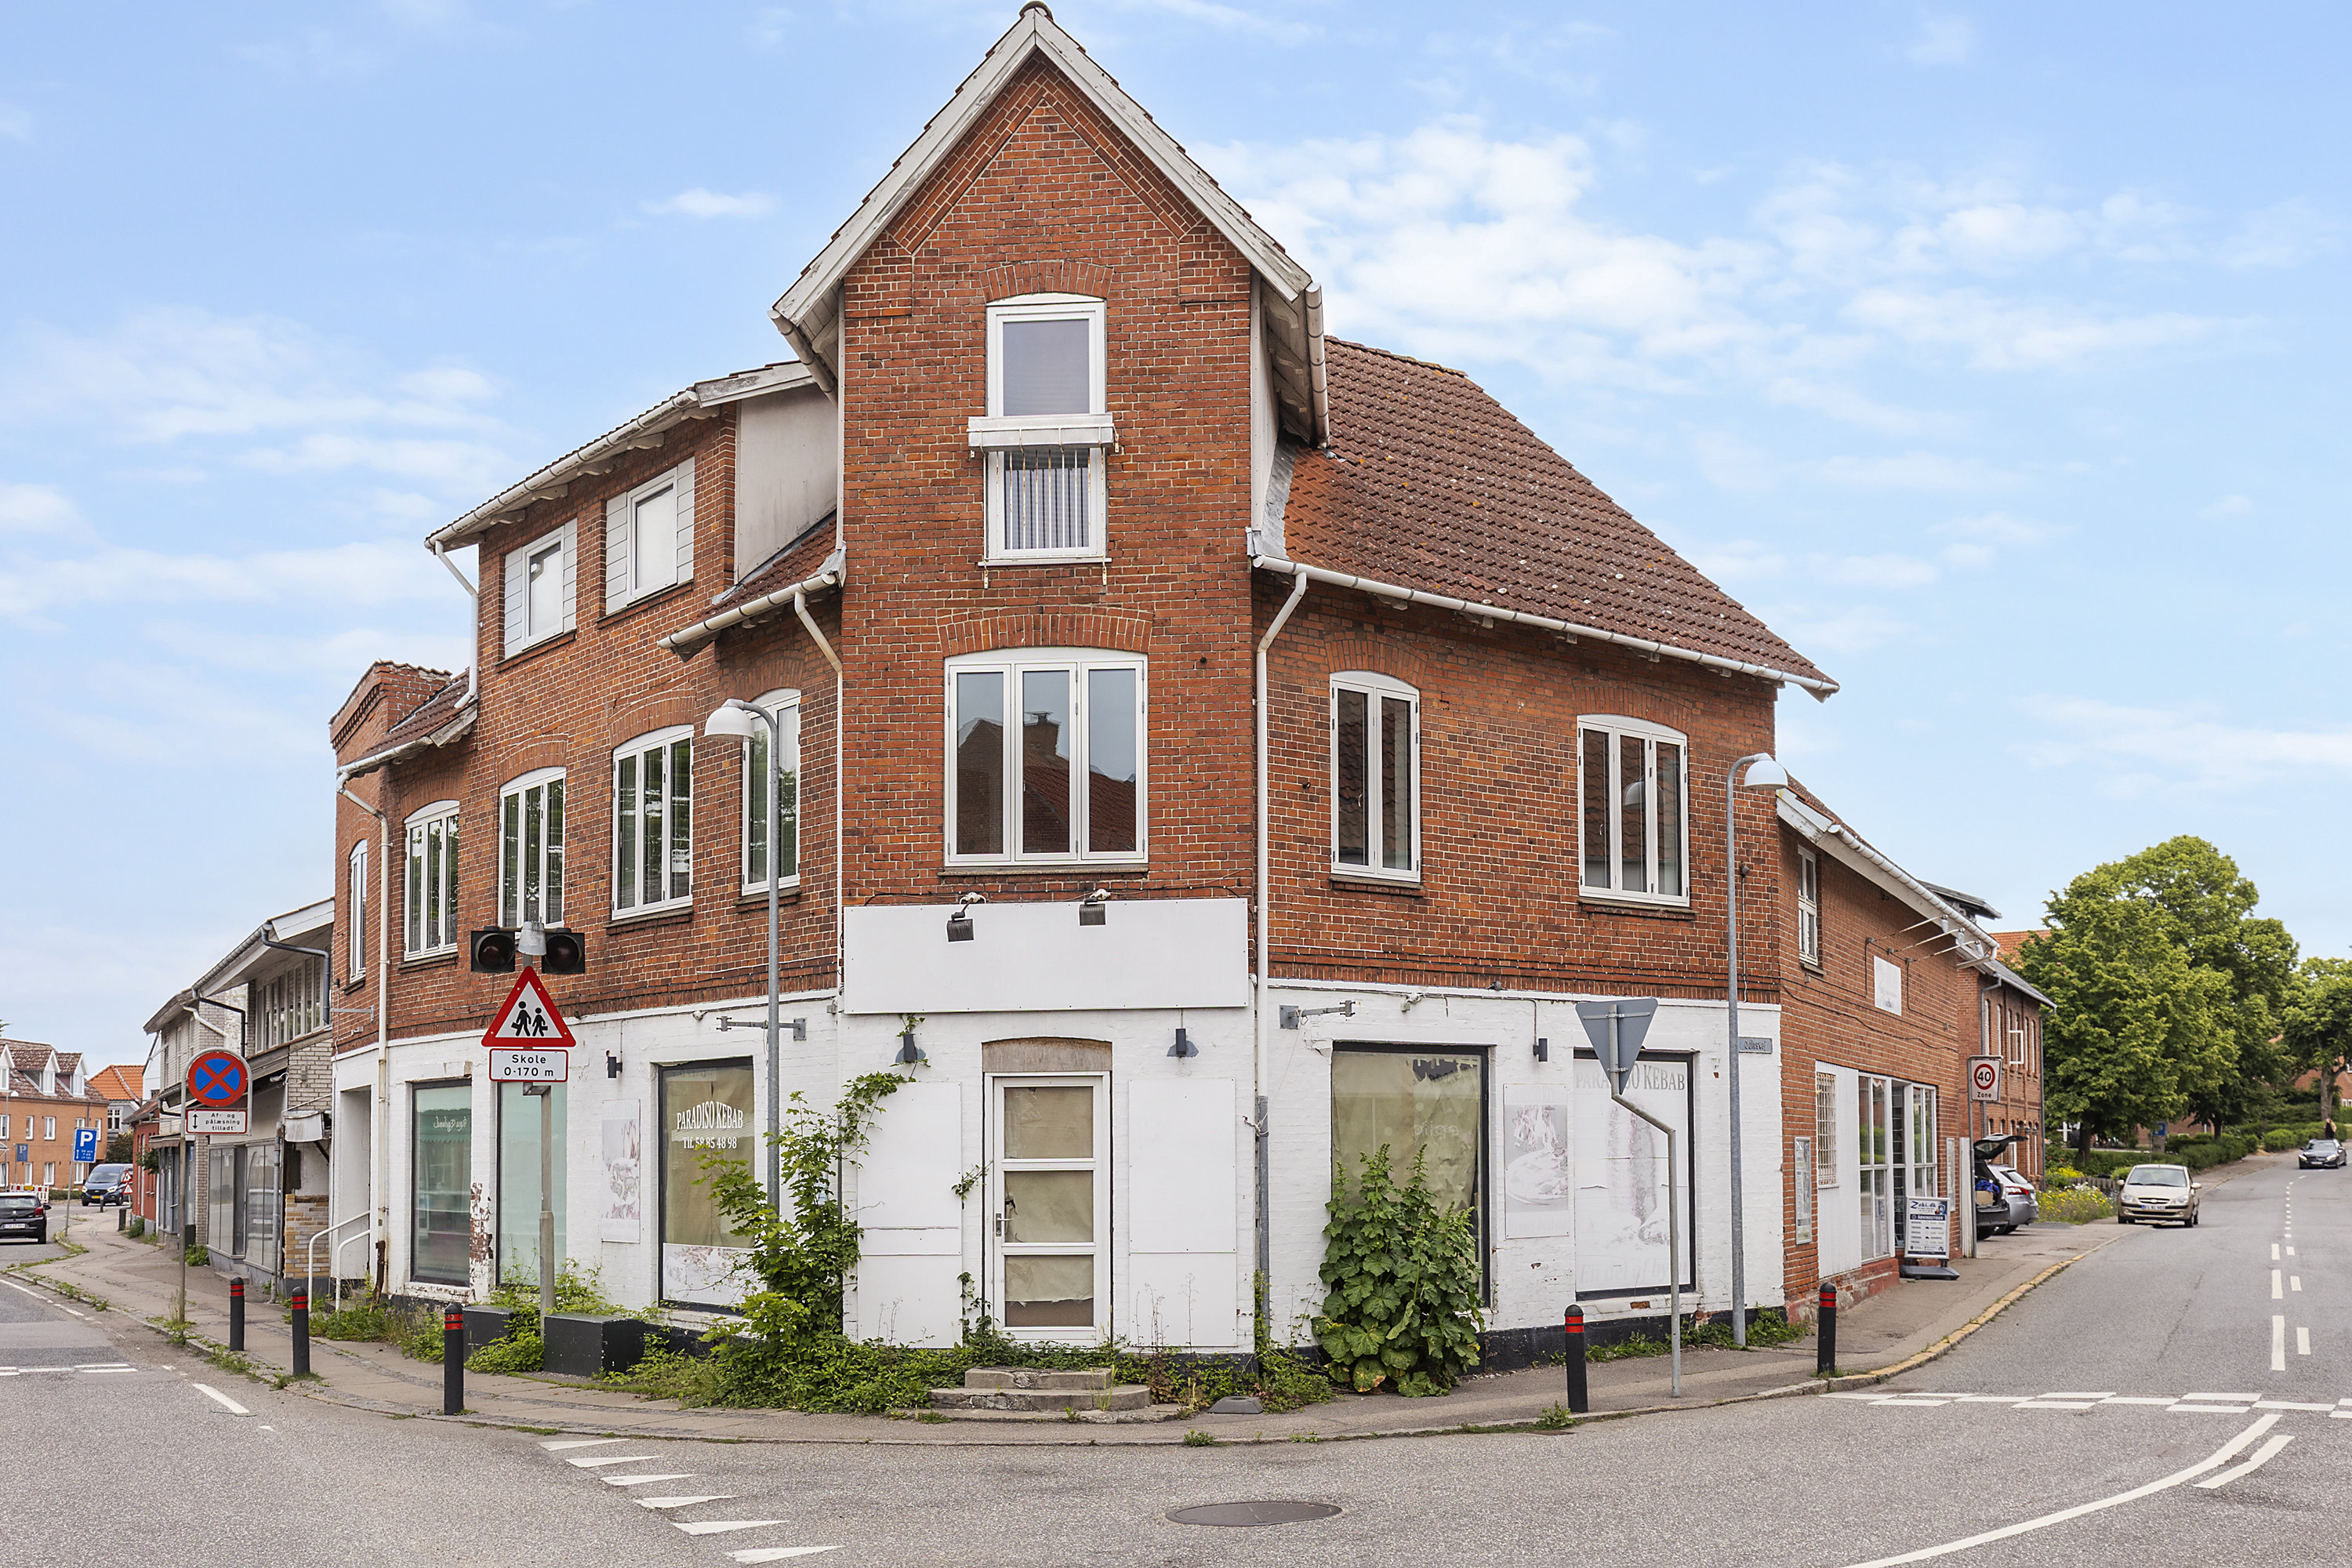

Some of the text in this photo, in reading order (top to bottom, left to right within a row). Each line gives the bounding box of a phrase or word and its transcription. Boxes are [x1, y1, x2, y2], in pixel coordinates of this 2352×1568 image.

[512, 1054, 546, 1064] Skole
[504, 1066, 539, 1076] 0-170
[1643, 1064, 1685, 1091] KEBAB
[1977, 1071, 1991, 1082] 40
[677, 1100, 743, 1130] PARADISO KEBAB
[80, 1131, 93, 1147] P
[683, 1136, 694, 1149] Tlf.
[706, 1136, 715, 1149] 85
[717, 1136, 726, 1149] 48
[728, 1136, 737, 1149] 98
